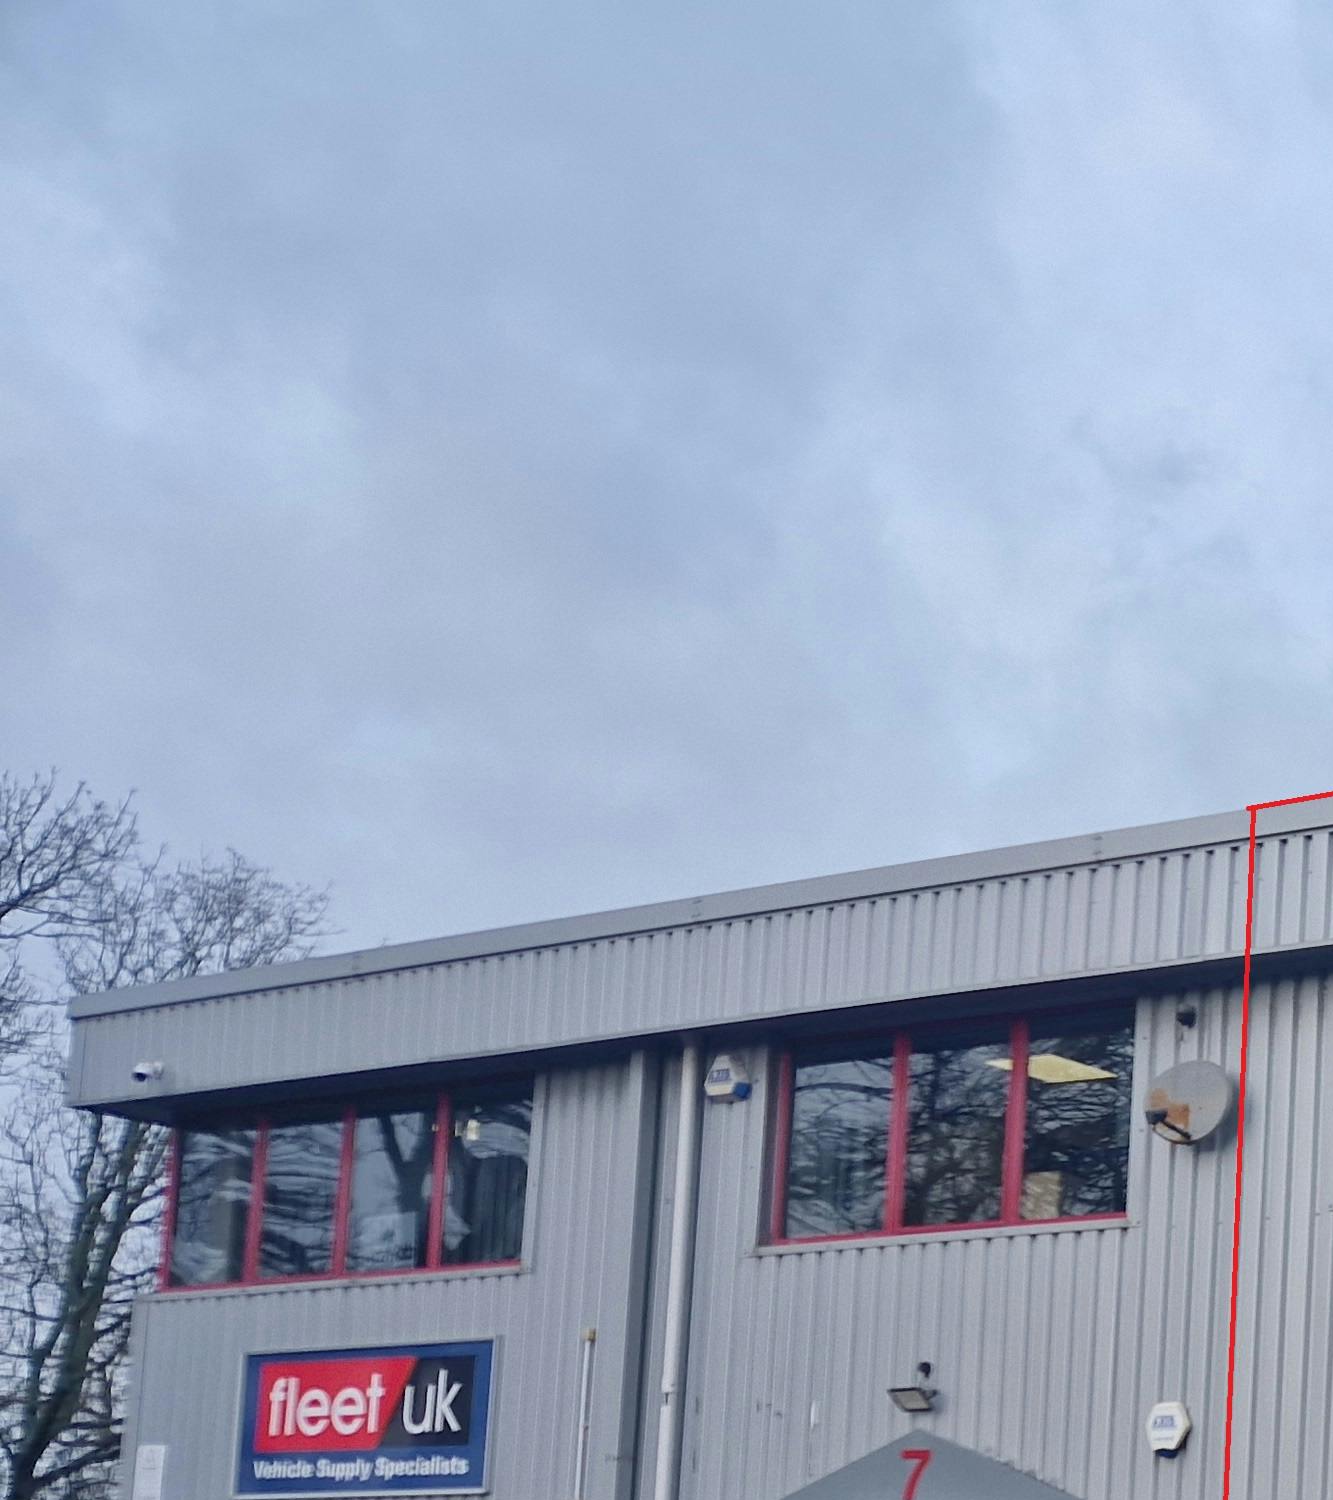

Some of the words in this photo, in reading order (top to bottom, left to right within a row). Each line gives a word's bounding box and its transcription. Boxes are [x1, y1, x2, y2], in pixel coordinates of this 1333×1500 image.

[268, 1373, 386, 1437] fleet
[402, 1368, 464, 1435] uk
[253, 1459, 315, 1480] Vehicle
[316, 1458, 374, 1482] Supply
[374, 1455, 470, 1481] Specialists
